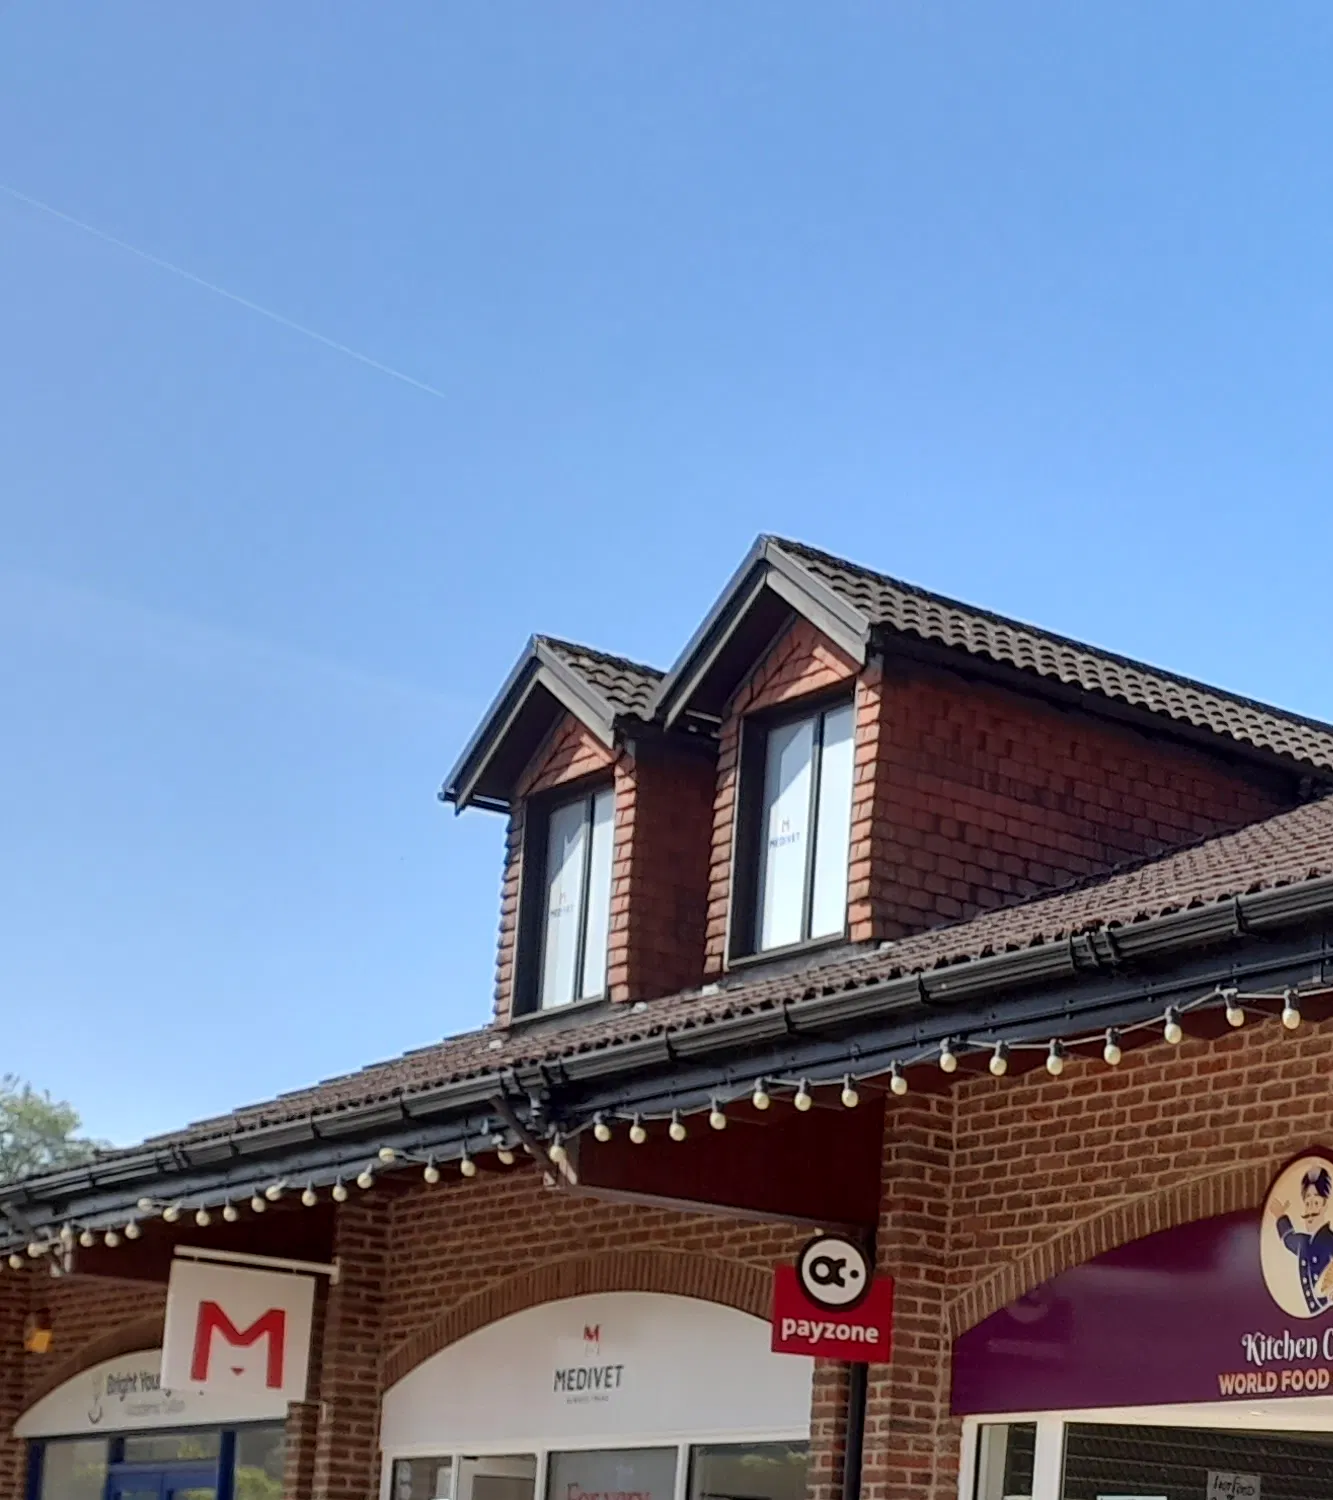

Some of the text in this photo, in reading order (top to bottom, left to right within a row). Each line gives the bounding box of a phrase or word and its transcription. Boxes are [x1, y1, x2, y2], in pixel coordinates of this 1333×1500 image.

[781, 1317, 880, 1344] payzone
[1241, 1331, 1318, 1366] Kitchen
[553, 1363, 625, 1393] MEDIVET
[1218, 1372, 1278, 1396] WORLD
[1281, 1368, 1331, 1392] FOOD
